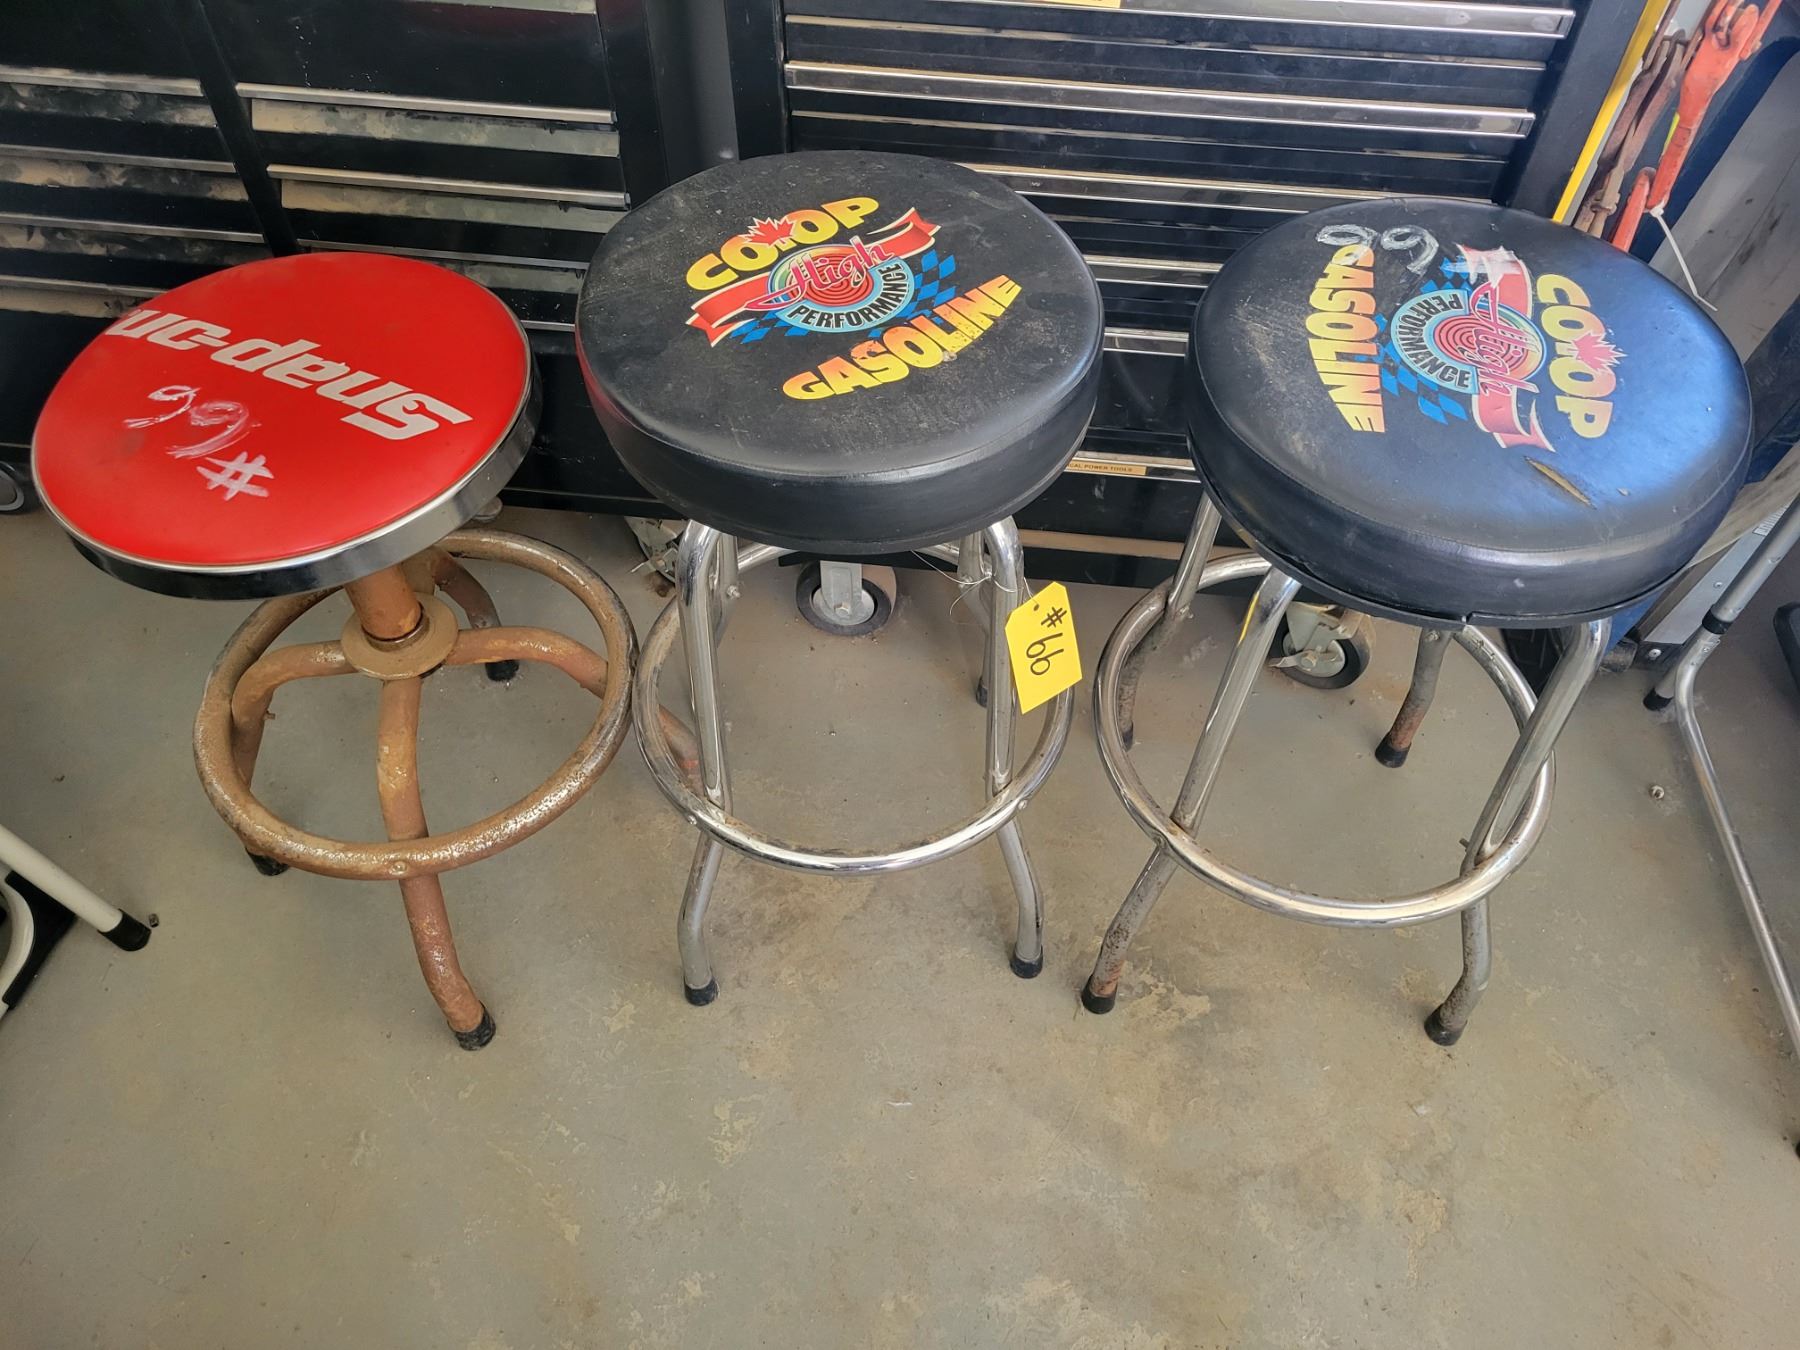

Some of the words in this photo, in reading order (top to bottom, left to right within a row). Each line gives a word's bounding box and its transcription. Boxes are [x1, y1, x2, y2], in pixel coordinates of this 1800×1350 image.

[743, 236, 894, 311] High
[786, 262, 904, 329] PERFORMANCE
[106, 308, 473, 441] Snap-on
[781, 273, 1023, 400] GASOLINE
[1304, 244, 1386, 433] GASOLINE
[1398, 292, 1471, 391] PERFORMANCE
[1470, 281, 1541, 397] High
